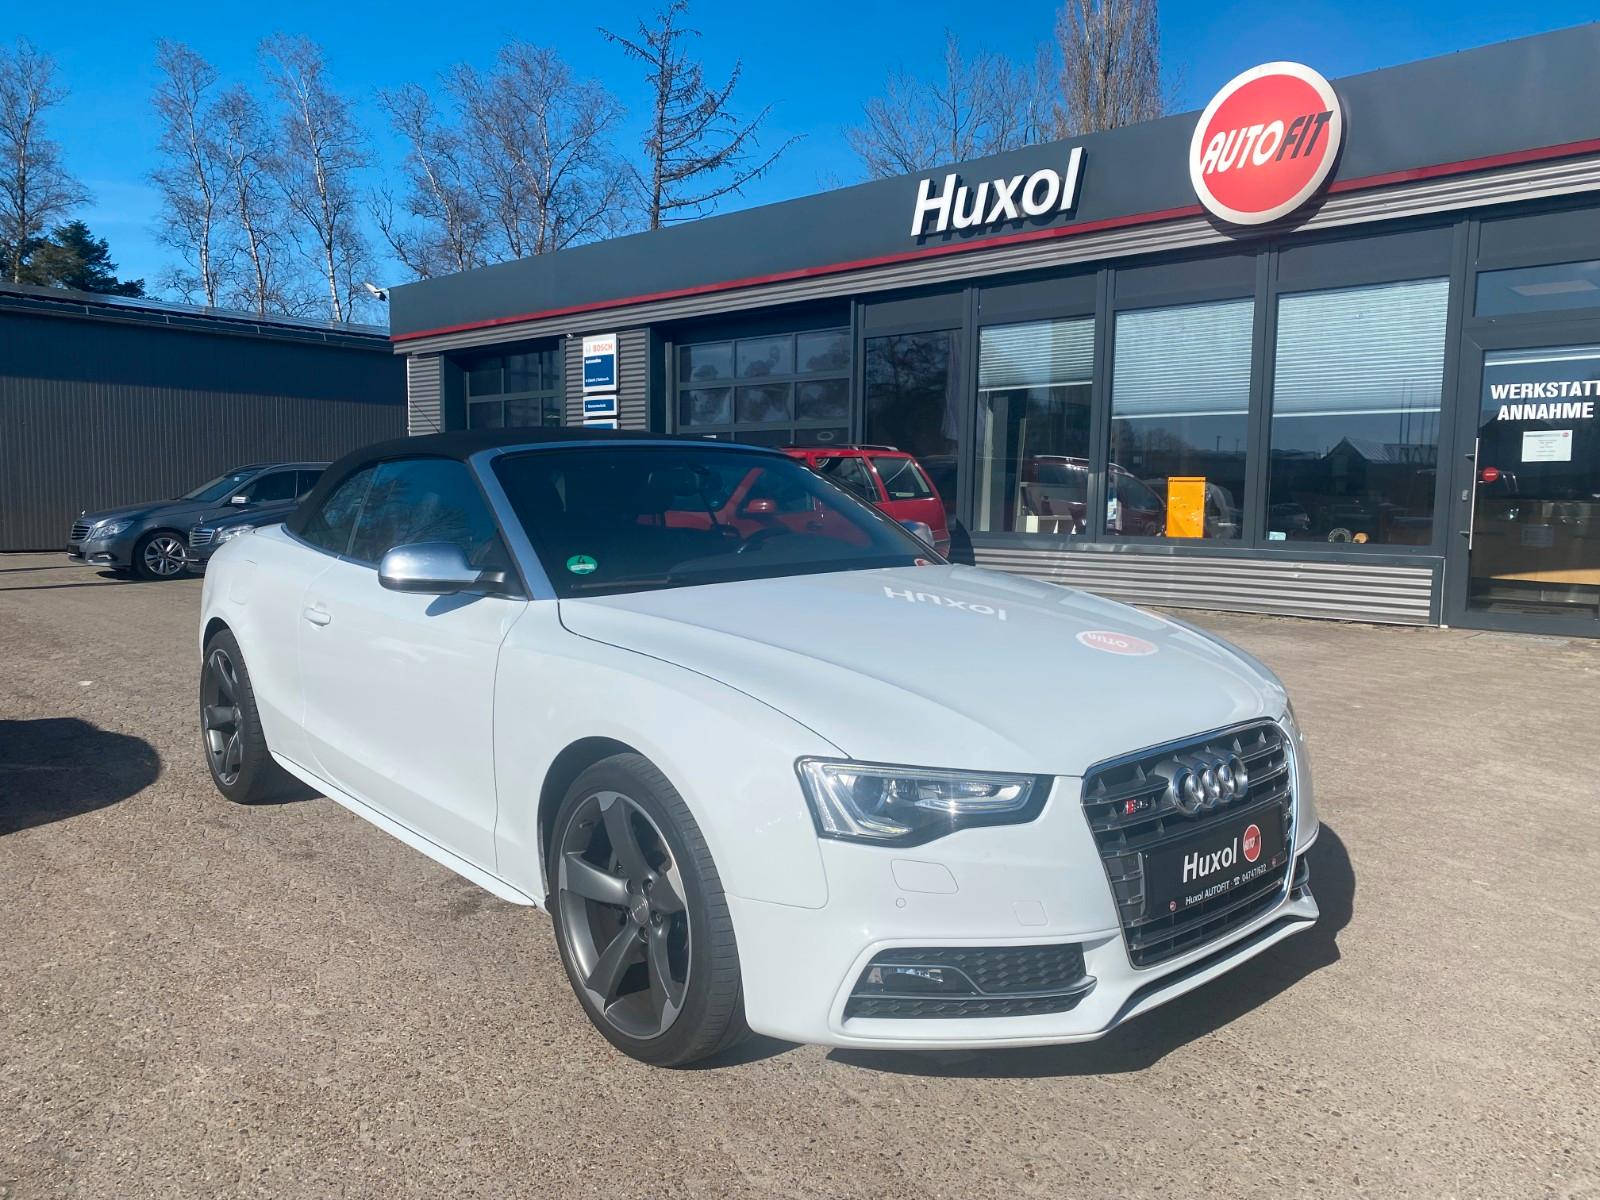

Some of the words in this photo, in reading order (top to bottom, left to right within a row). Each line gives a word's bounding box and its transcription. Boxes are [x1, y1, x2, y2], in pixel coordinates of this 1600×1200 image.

[1201, 110, 1333, 176] AUTOFIT
[910, 146, 1085, 237] Huxol
[592, 343, 613, 353] BOSCH
[1490, 380, 1600, 400] WERKSTATT
[1497, 402, 1594, 421] ANNAHME
[1183, 837, 1238, 883] Huxol
[1185, 891, 1204, 906] Huxol
[1204, 880, 1230, 899] AUTOFIT
